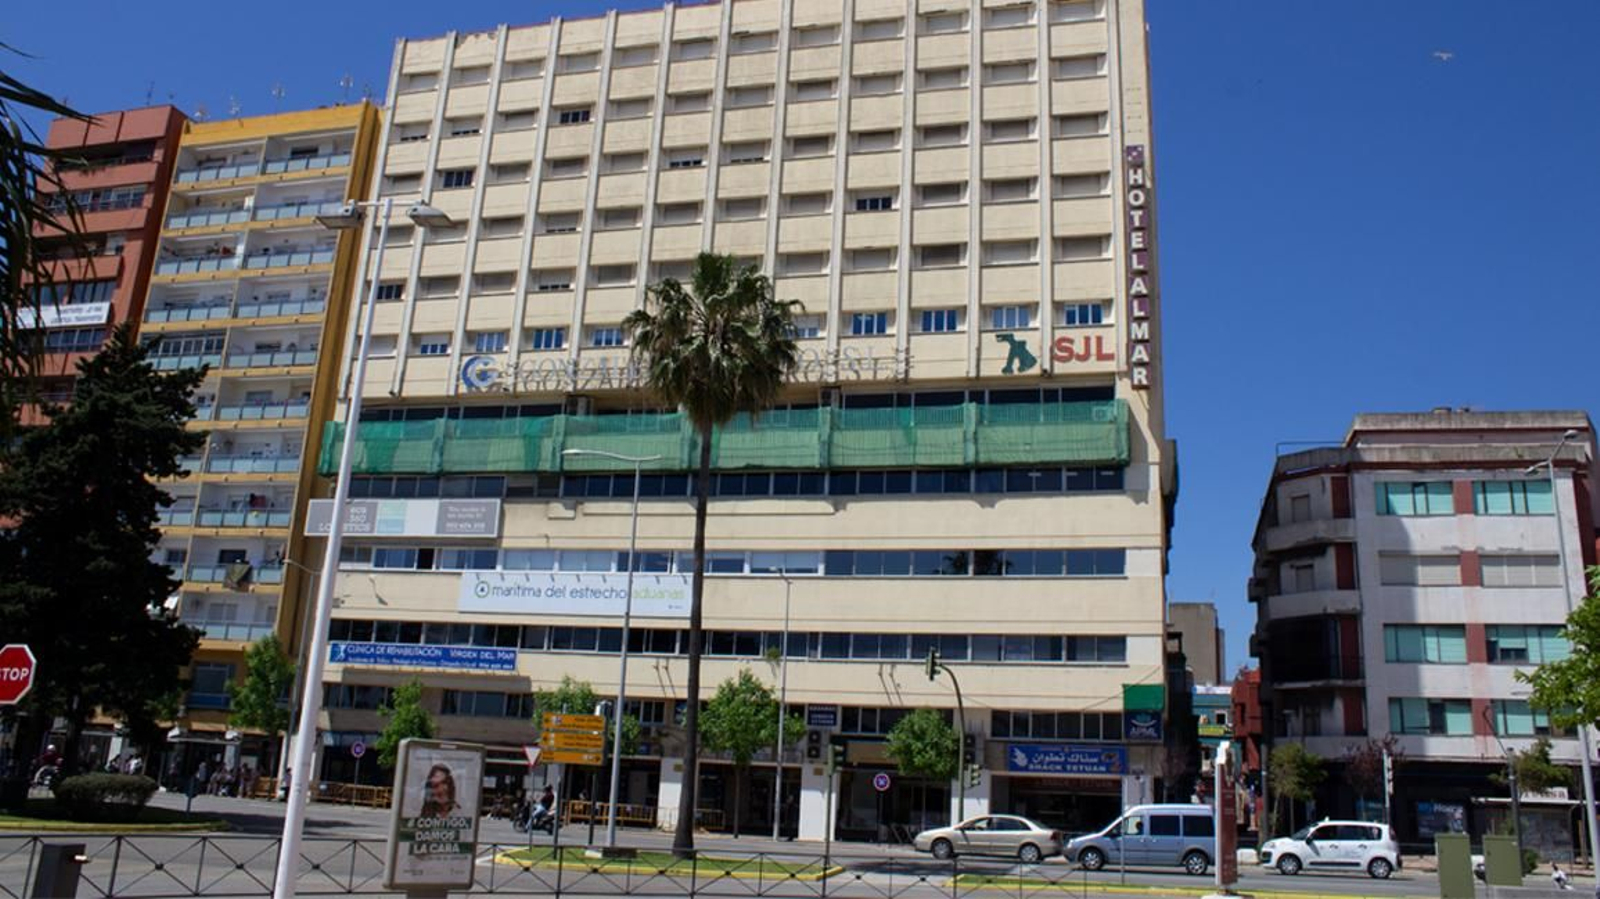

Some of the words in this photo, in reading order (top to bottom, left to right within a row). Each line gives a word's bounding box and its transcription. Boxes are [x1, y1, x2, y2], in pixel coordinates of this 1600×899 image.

[1128, 168, 1145, 270] HOTEL
[1054, 336, 1115, 363] SJL
[545, 585, 567, 598] del
[569, 586, 627, 599] estrecho
[0, 667, 29, 681] TOP
[415, 831, 455, 841] DAMOS
[413, 844, 428, 854] LA
[429, 843, 460, 853] CARA
